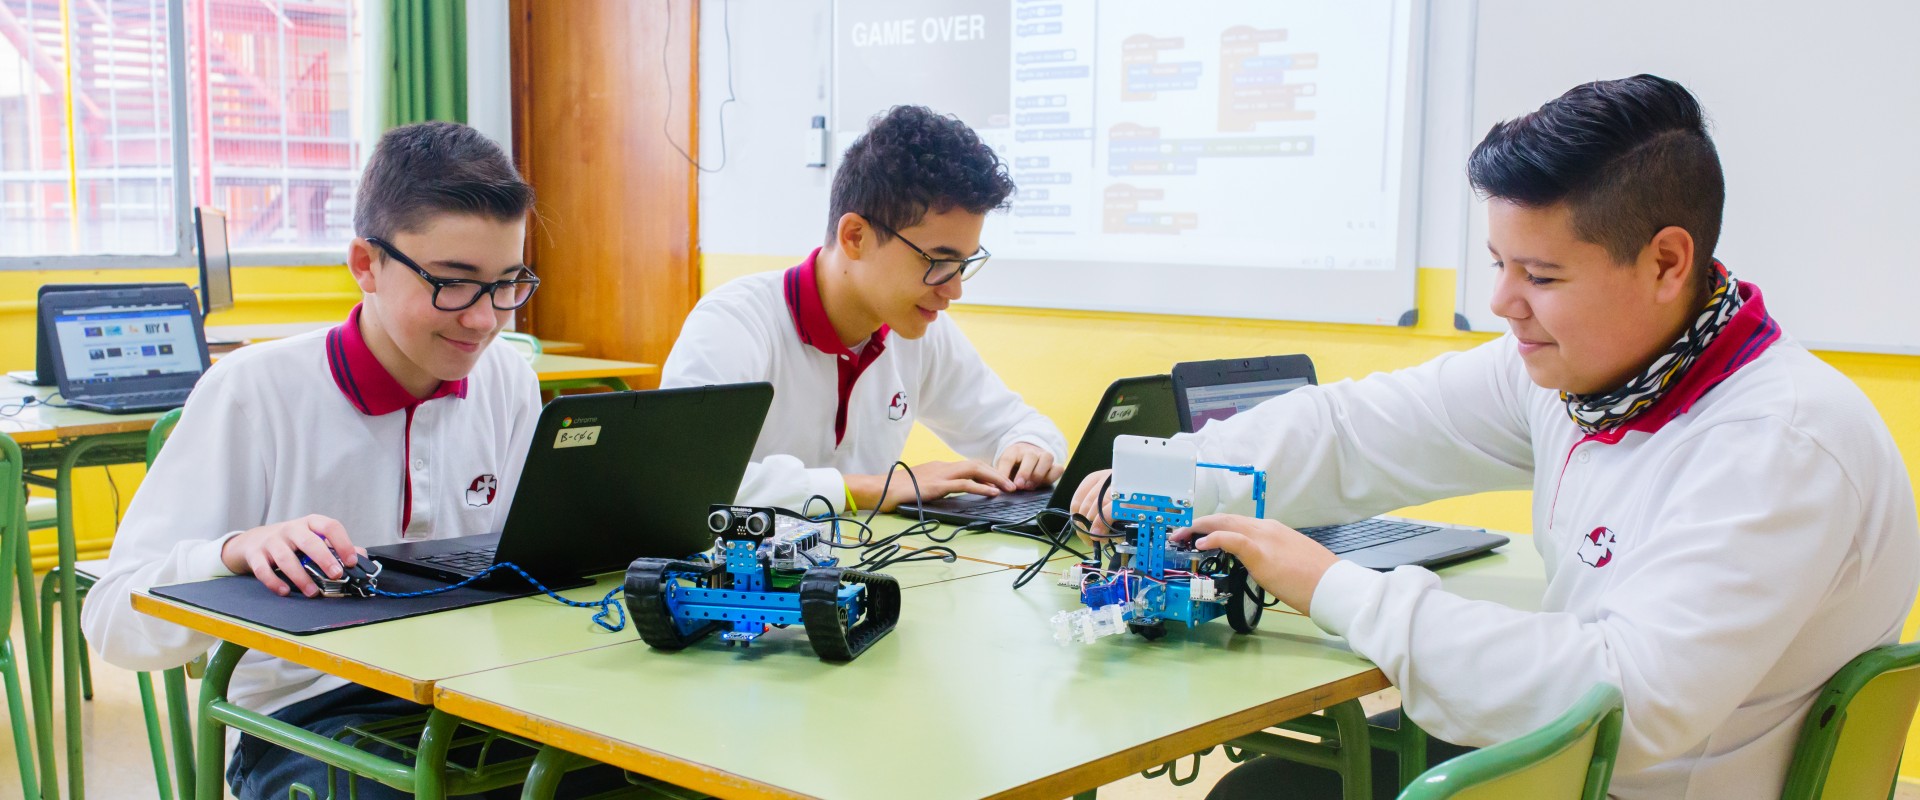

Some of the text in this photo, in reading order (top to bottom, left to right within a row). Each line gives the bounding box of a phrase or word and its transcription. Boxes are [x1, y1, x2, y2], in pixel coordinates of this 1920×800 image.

[851, 14, 986, 47] GAME OVER
[574, 416, 598, 424] chrome
